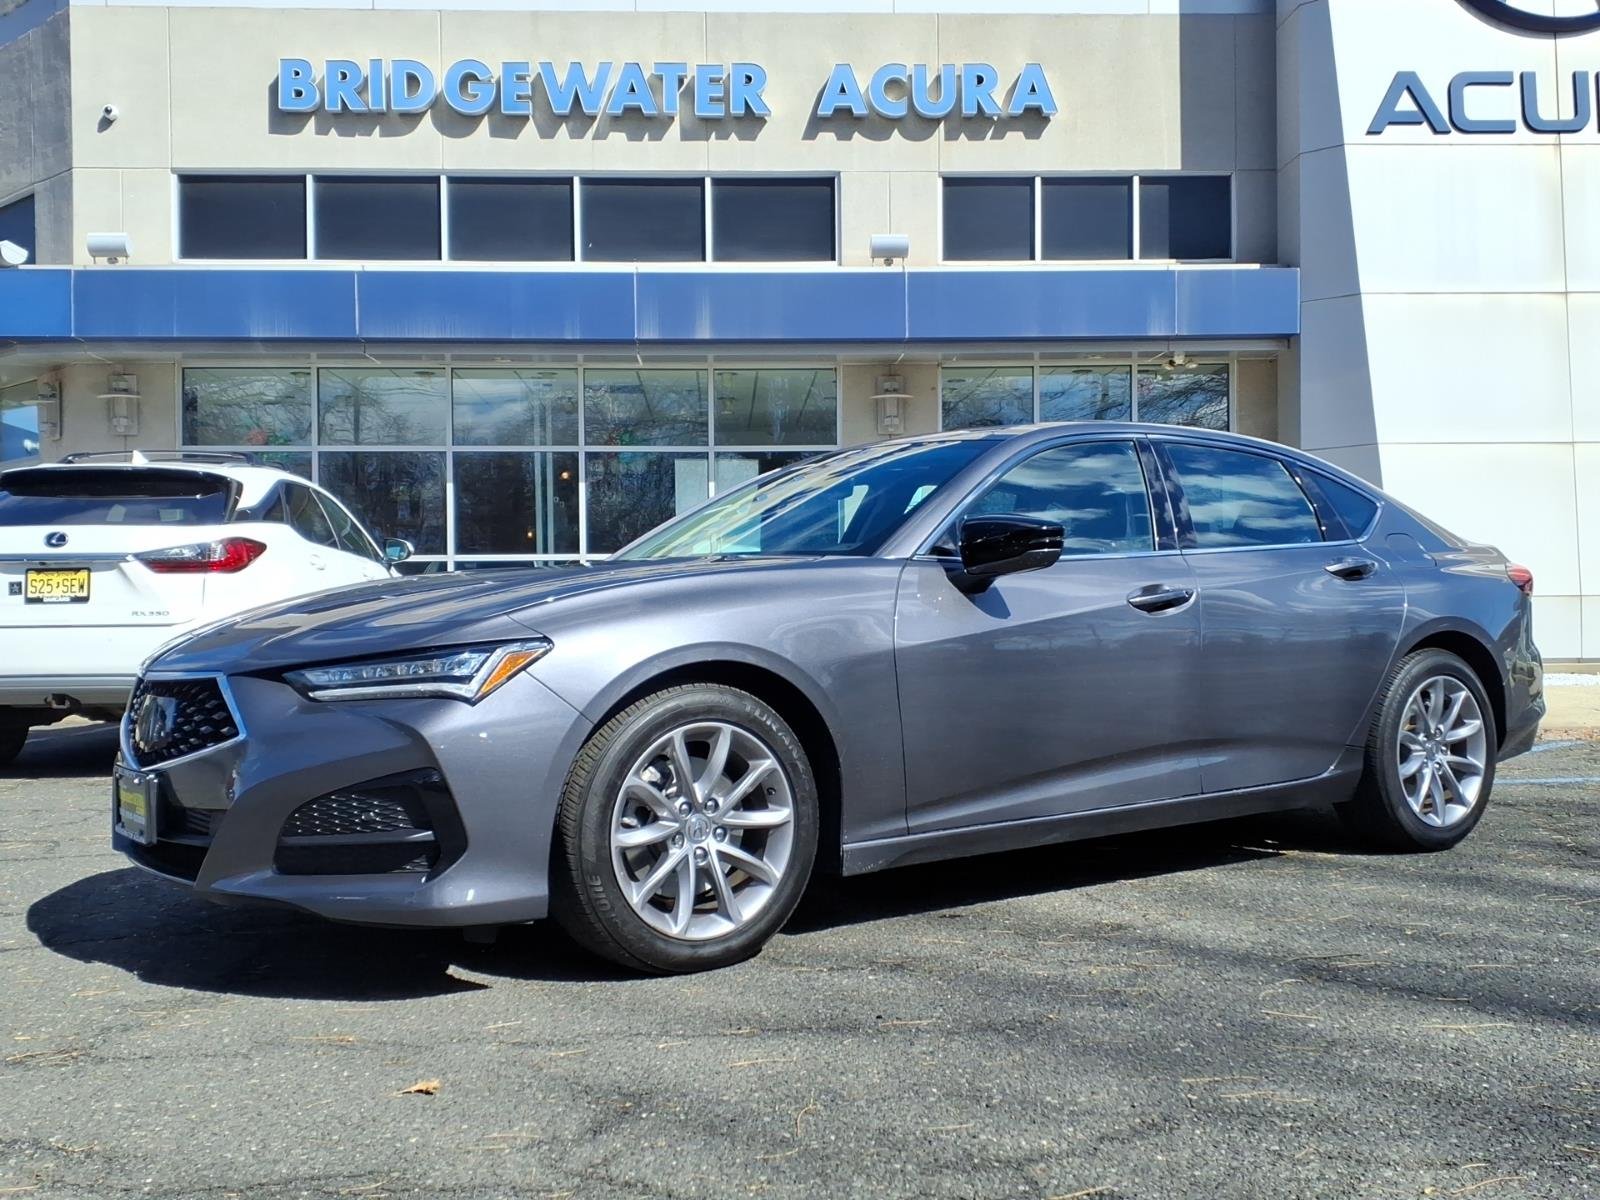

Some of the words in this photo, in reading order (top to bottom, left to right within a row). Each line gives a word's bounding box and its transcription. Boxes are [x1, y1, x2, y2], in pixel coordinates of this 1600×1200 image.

[279, 58, 771, 117] BRIDGEWATER
[817, 63, 1058, 118] ACURA
[1365, 71, 1600, 135] ACU
